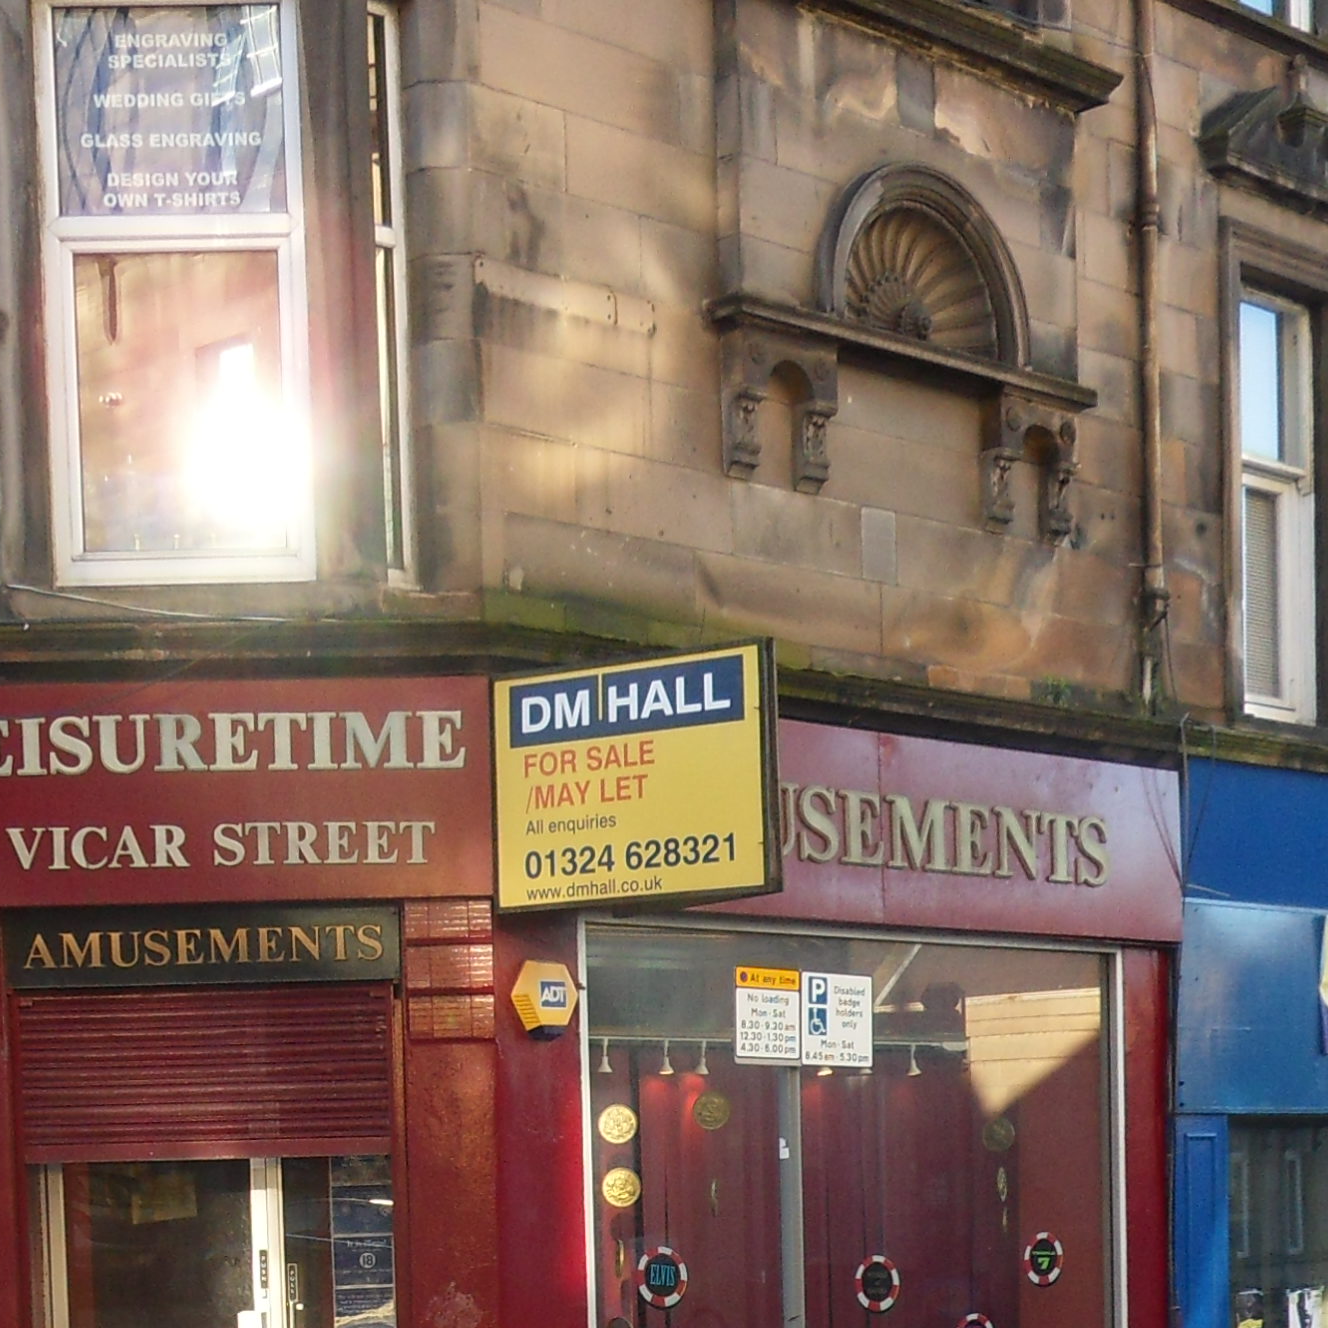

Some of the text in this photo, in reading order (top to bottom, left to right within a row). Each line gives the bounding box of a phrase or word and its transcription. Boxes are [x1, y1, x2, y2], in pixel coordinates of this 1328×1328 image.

[115, 33, 228, 48] ENGRAVING
[108, 53, 232, 69] SPECIALISTS
[93, 93, 184, 108] WEDDING
[80, 132, 262, 148] GLASS ENGRAVING
[107, 171, 238, 188] DESIGN YOUR
[103, 190, 242, 208] OWN T-SHIRTS
[521, 672, 731, 734] DM HALL
[524, 739, 656, 778] FOR SALE
[600, 774, 649, 804] LET
[526, 814, 617, 835] All enquiries
[5, 824, 191, 870] VICAR
[213, 821, 437, 867] STREET
[525, 832, 736, 880] 01324 628321
[526, 876, 663, 901] www.dmhall.co.uk
[22, 923, 385, 970] AMUSEMENTS
[750, 973, 796, 985] At any time
[541, 985, 568, 1003] ADT
[811, 978, 826, 1003] P
[833, 985, 866, 997] Disabled
[747, 993, 790, 1006] No loading
[838, 998, 860, 1008] badge
[835, 1008, 863, 1018] holders
[841, 1020, 857, 1030] only
[362, 1254, 374, 1267] 18
[650, 1263, 676, 1287] ELVIS
